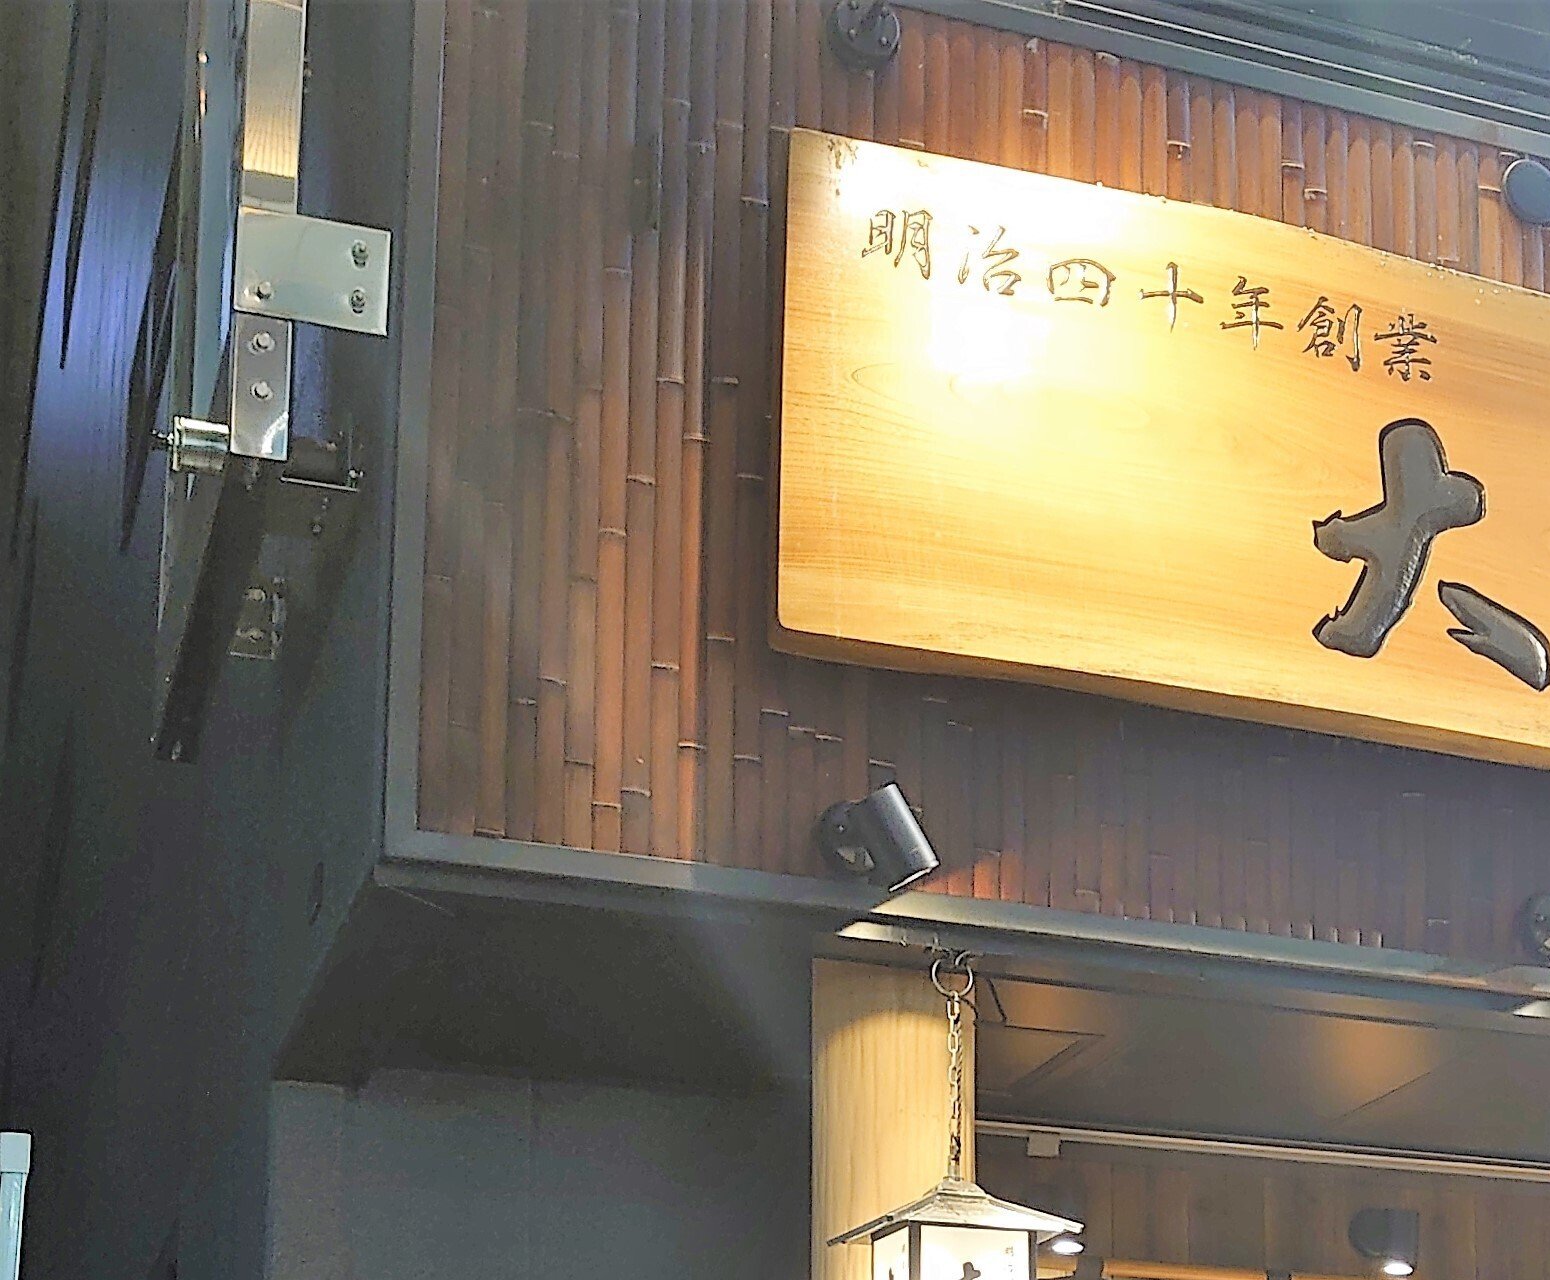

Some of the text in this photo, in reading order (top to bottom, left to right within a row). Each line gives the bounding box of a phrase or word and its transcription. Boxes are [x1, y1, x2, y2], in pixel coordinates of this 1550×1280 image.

[861, 209, 1438, 382] 明治四十年創業
